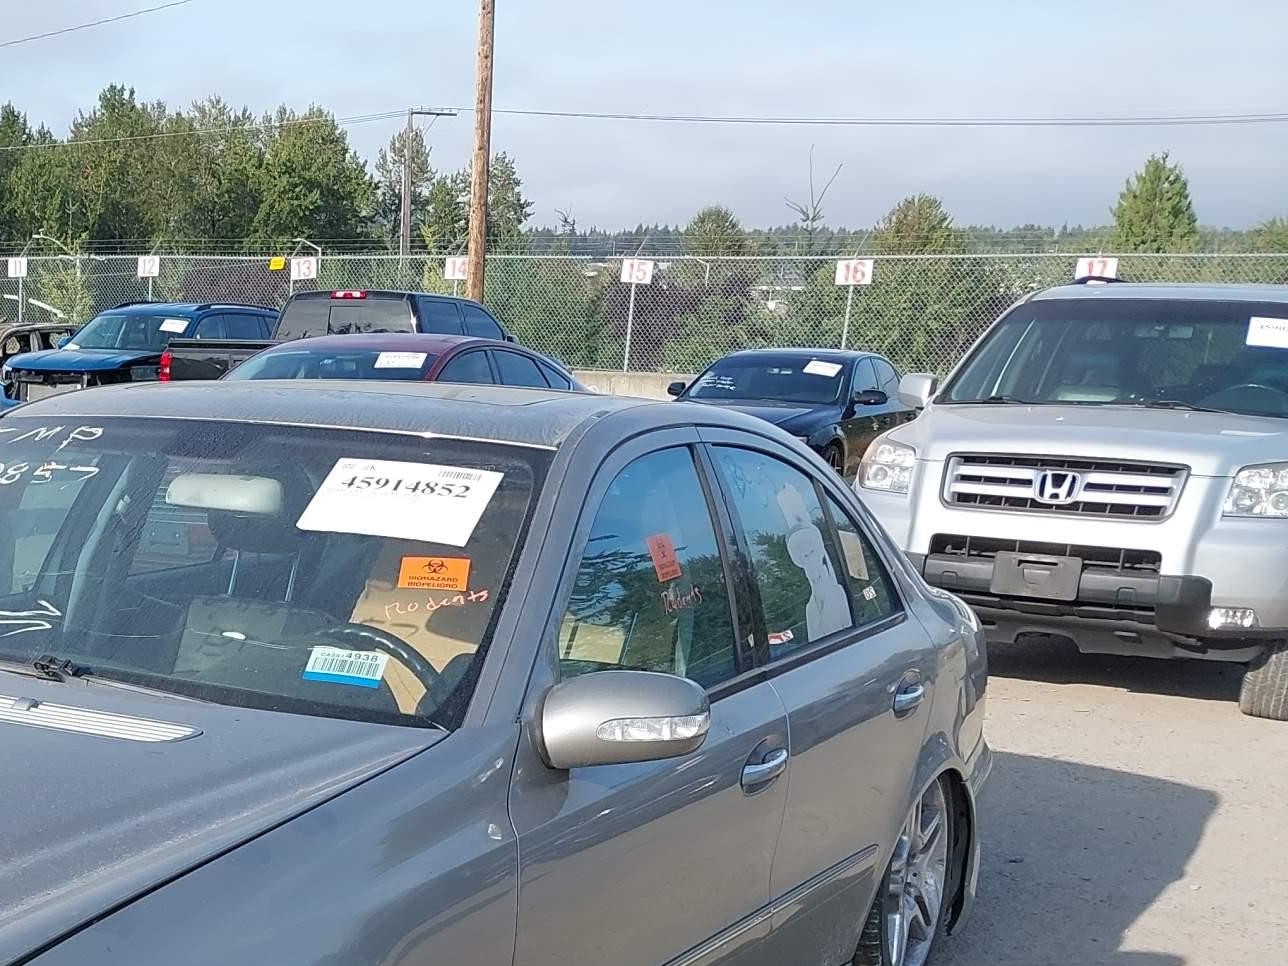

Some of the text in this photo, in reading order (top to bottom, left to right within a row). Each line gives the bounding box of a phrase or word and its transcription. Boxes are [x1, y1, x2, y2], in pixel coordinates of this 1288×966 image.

[13, 259, 22, 275] 11
[142, 258, 155, 275] 12
[296, 259, 312, 277] 13
[451, 259, 468, 277] 14
[628, 261, 648, 282] 15
[844, 261, 866, 283] 16
[1087, 259, 1108, 276] 17
[341, 475, 472, 499] 45914852
[407, 581, 459, 589] BIOPELIGRO
[408, 575, 459, 583] BIOHAZARD
